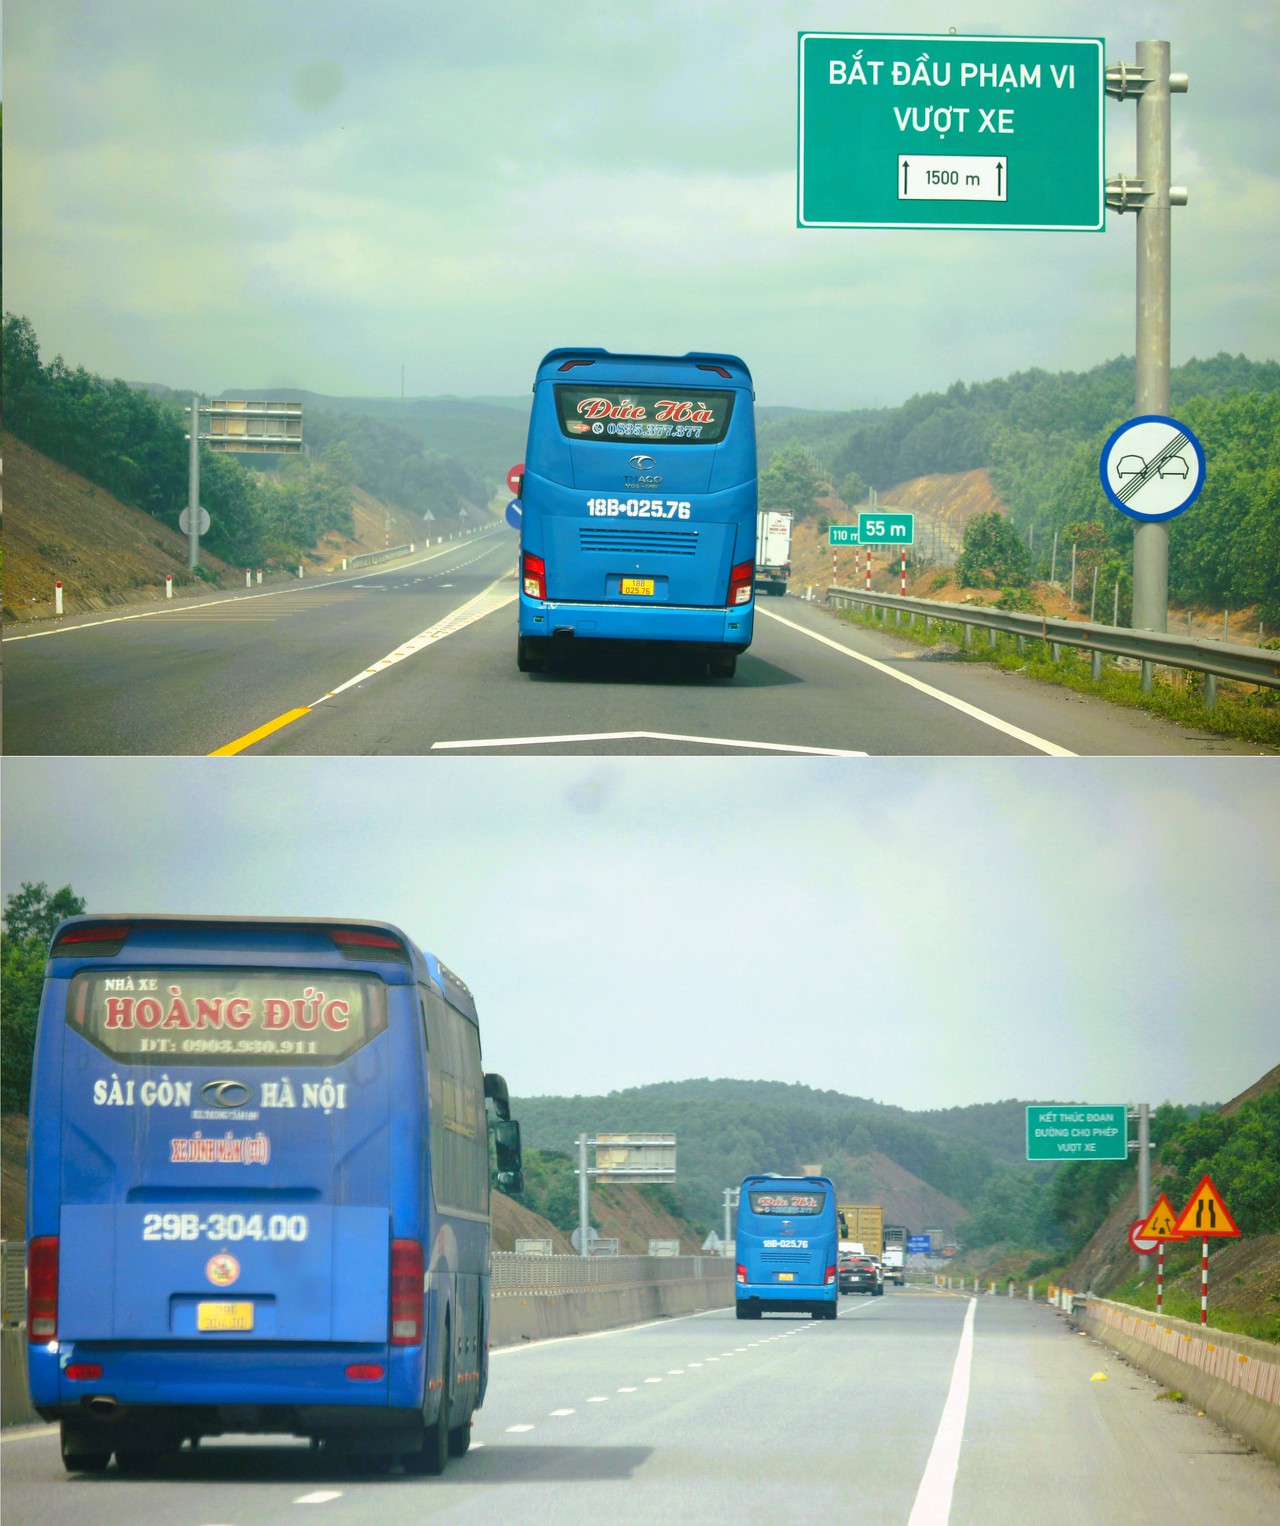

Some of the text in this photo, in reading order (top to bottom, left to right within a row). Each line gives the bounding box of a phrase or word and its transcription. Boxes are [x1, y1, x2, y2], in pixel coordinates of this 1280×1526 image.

[829, 49, 1075, 93] BẮT ĐẦU PHẠM VI
[893, 105, 1015, 139] VƯỢT XE
[925, 169, 980, 186] 1500 m
[576, 397, 715, 423] Đức Hà
[606, 422, 703, 438] 0835.377.377
[833, 530, 848, 541] 110
[866, 521, 906, 536] 55 m
[104, 975, 158, 991] NHÀ XE
[103, 985, 352, 1032] HOÀNG ĐỨC
[92, 1073, 193, 1107] SÀI GÒN
[260, 1076, 348, 1115] HÀ NỘI
[142, 1213, 309, 1243] 29B-304.00
